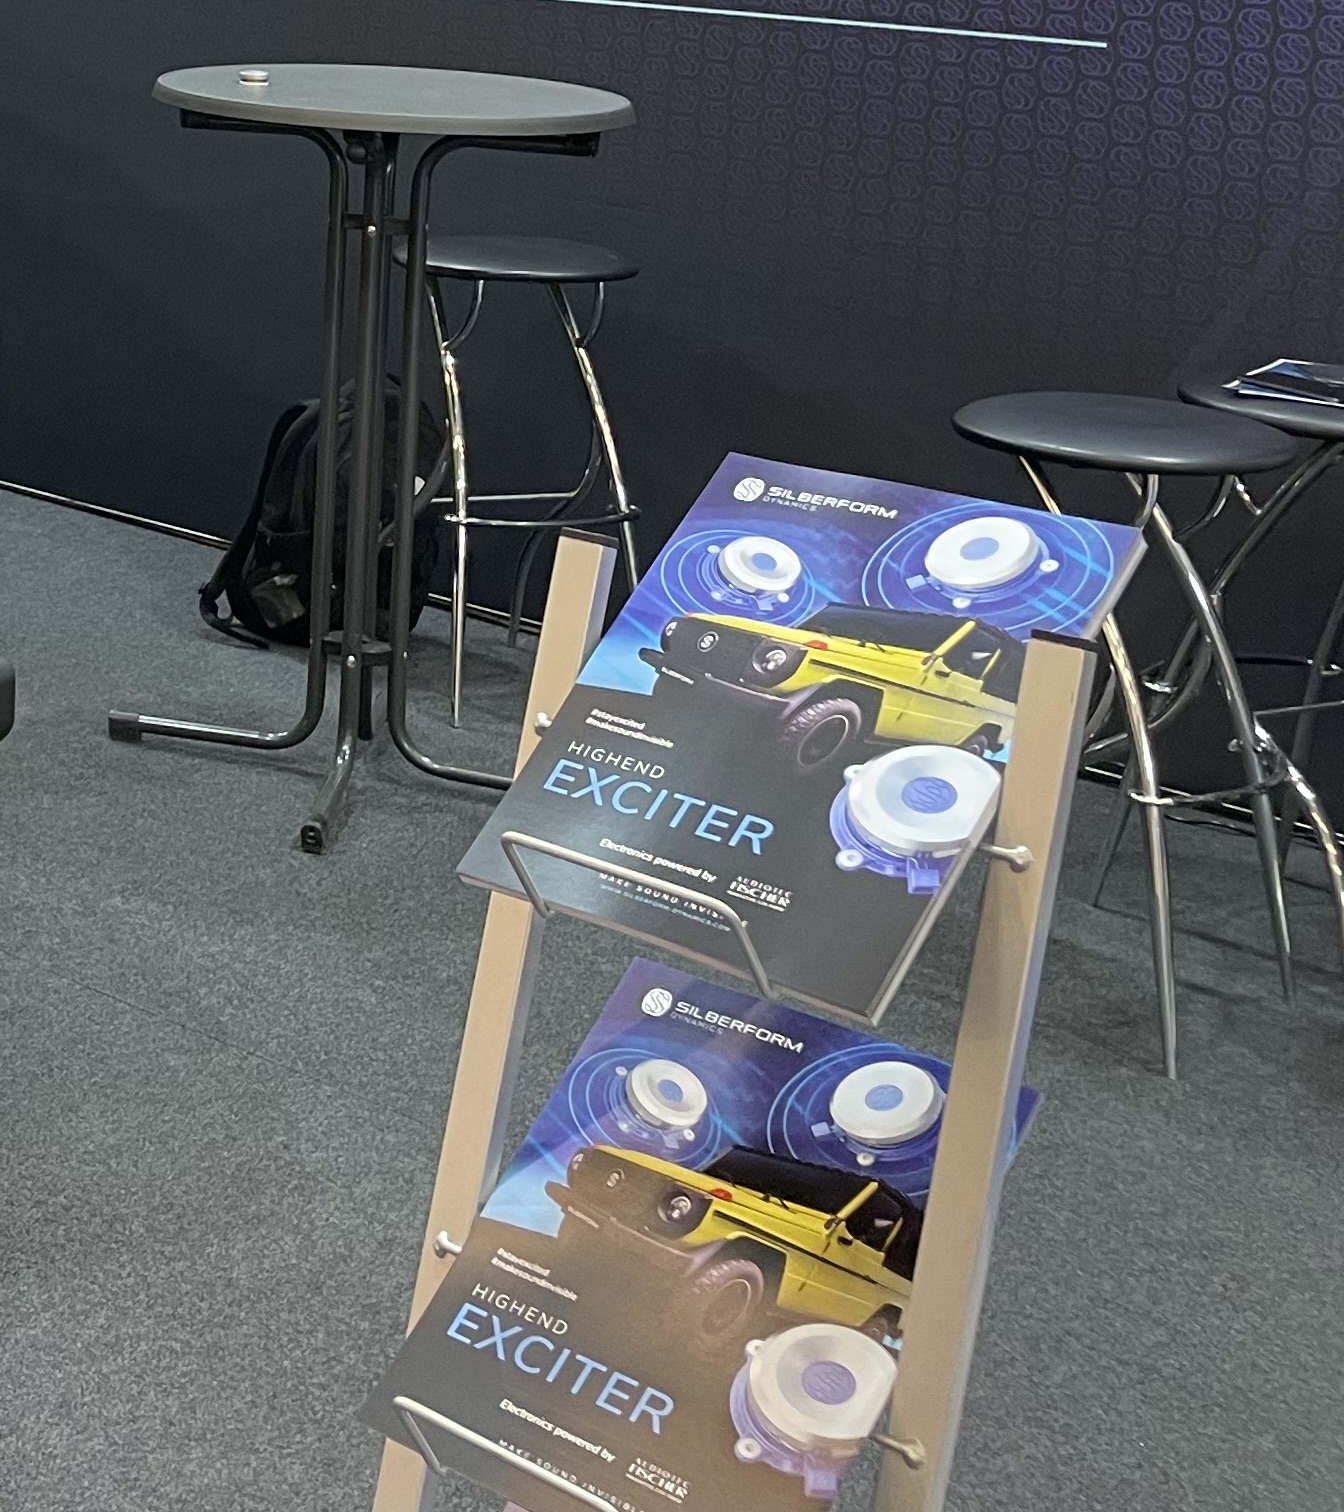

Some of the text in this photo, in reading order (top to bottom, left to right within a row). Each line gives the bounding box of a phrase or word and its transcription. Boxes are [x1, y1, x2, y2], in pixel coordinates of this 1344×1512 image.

[762, 495, 817, 512] DYNAMICS
[767, 486, 898, 519] SILBERFORM
[567, 740, 665, 779] HIGHEND
[542, 758, 775, 856] EXCITER
[599, 837, 717, 883] Electronics powered by
[636, 885, 679, 904] SOUND
[670, 1011, 724, 1035] DYNAMICS
[675, 1001, 804, 1054] SILBERFORM
[471, 1282, 569, 1335] HIGHEND
[446, 1300, 676, 1435] EXCITER
[499, 1398, 616, 1463] Electronics powered by
[536, 1457, 577, 1485] SOUND
